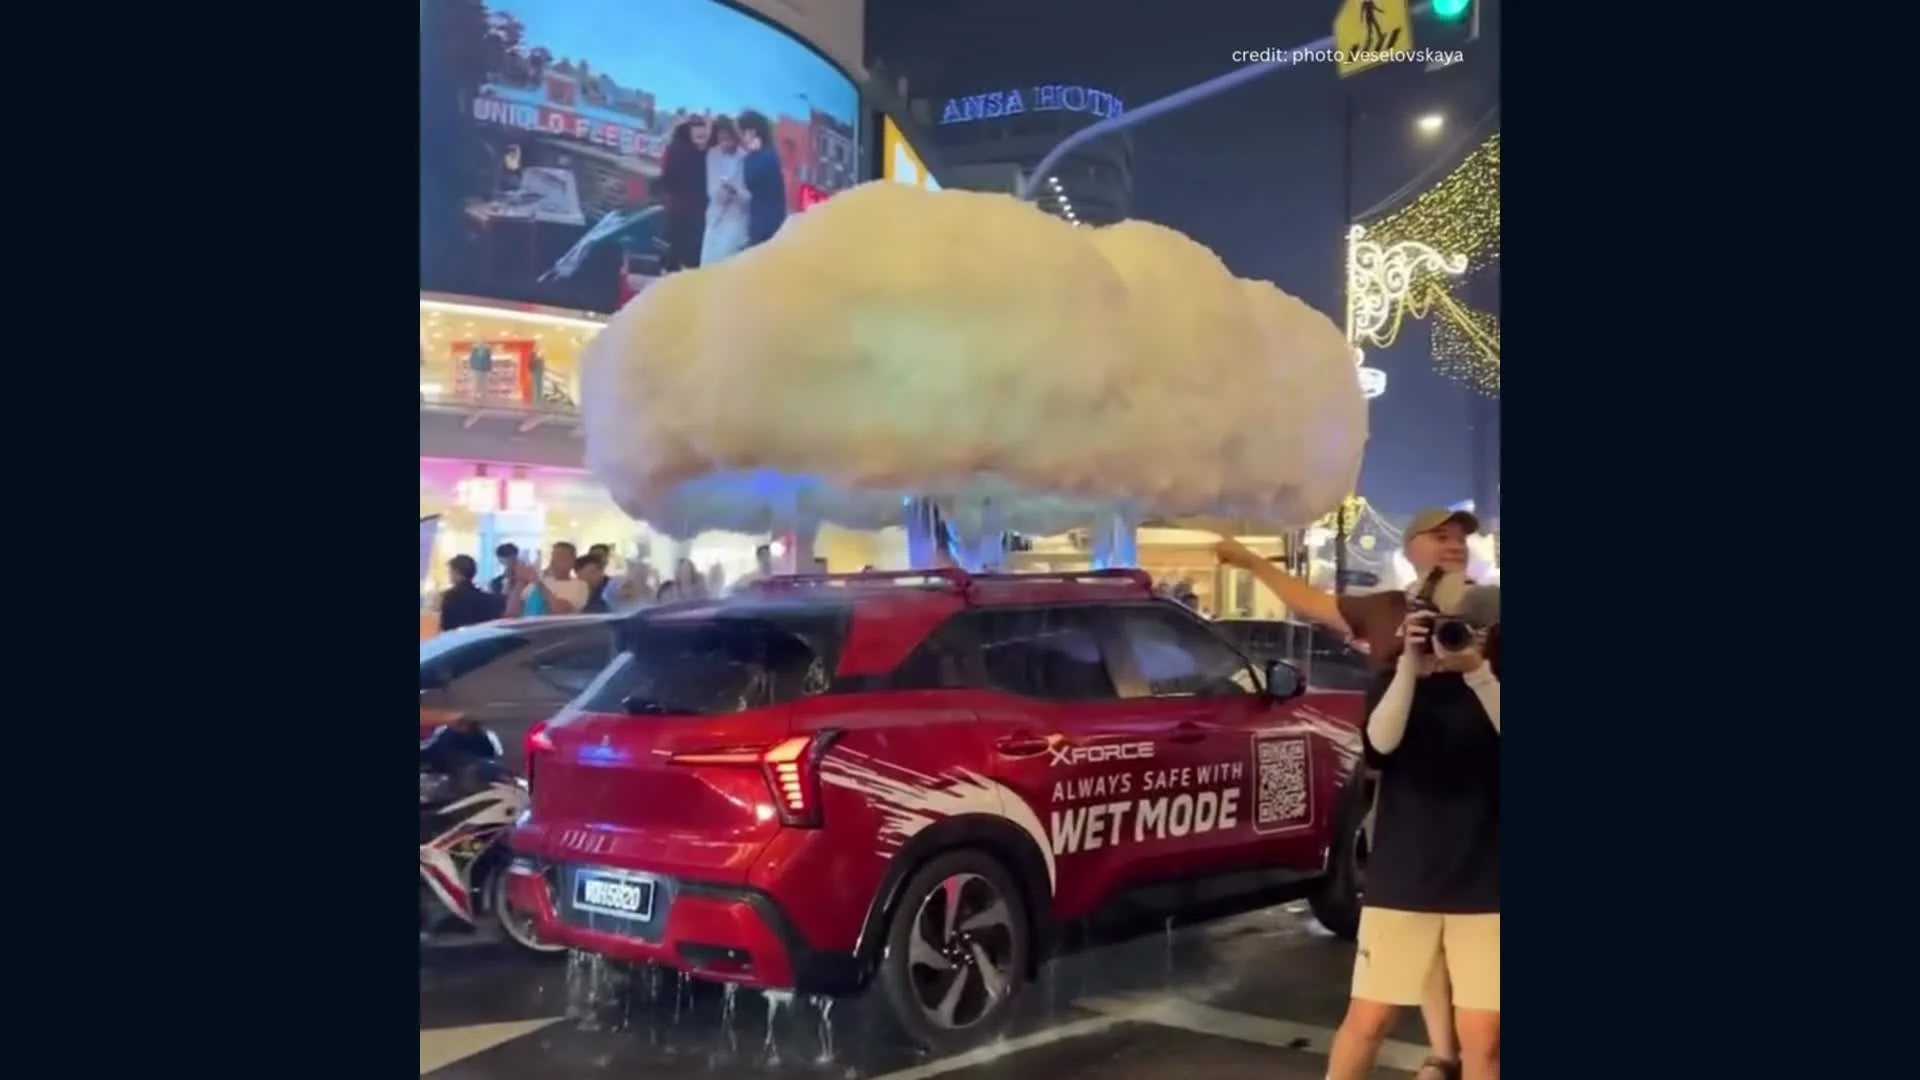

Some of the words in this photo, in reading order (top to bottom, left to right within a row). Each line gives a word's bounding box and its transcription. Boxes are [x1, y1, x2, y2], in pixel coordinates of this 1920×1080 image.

[473, 98, 565, 134] UNIQLO
[939, 88, 1025, 124] ANSA
[1034, 85, 1123, 120] HOTE
[1050, 741, 1155, 767] XFORCE
[1052, 772, 1132, 803] ALWAYS
[1143, 767, 1192, 791] SAFE
[1197, 761, 1243, 785] WITH
[1051, 801, 1132, 856] WET
[1134, 788, 1241, 843] MODE
